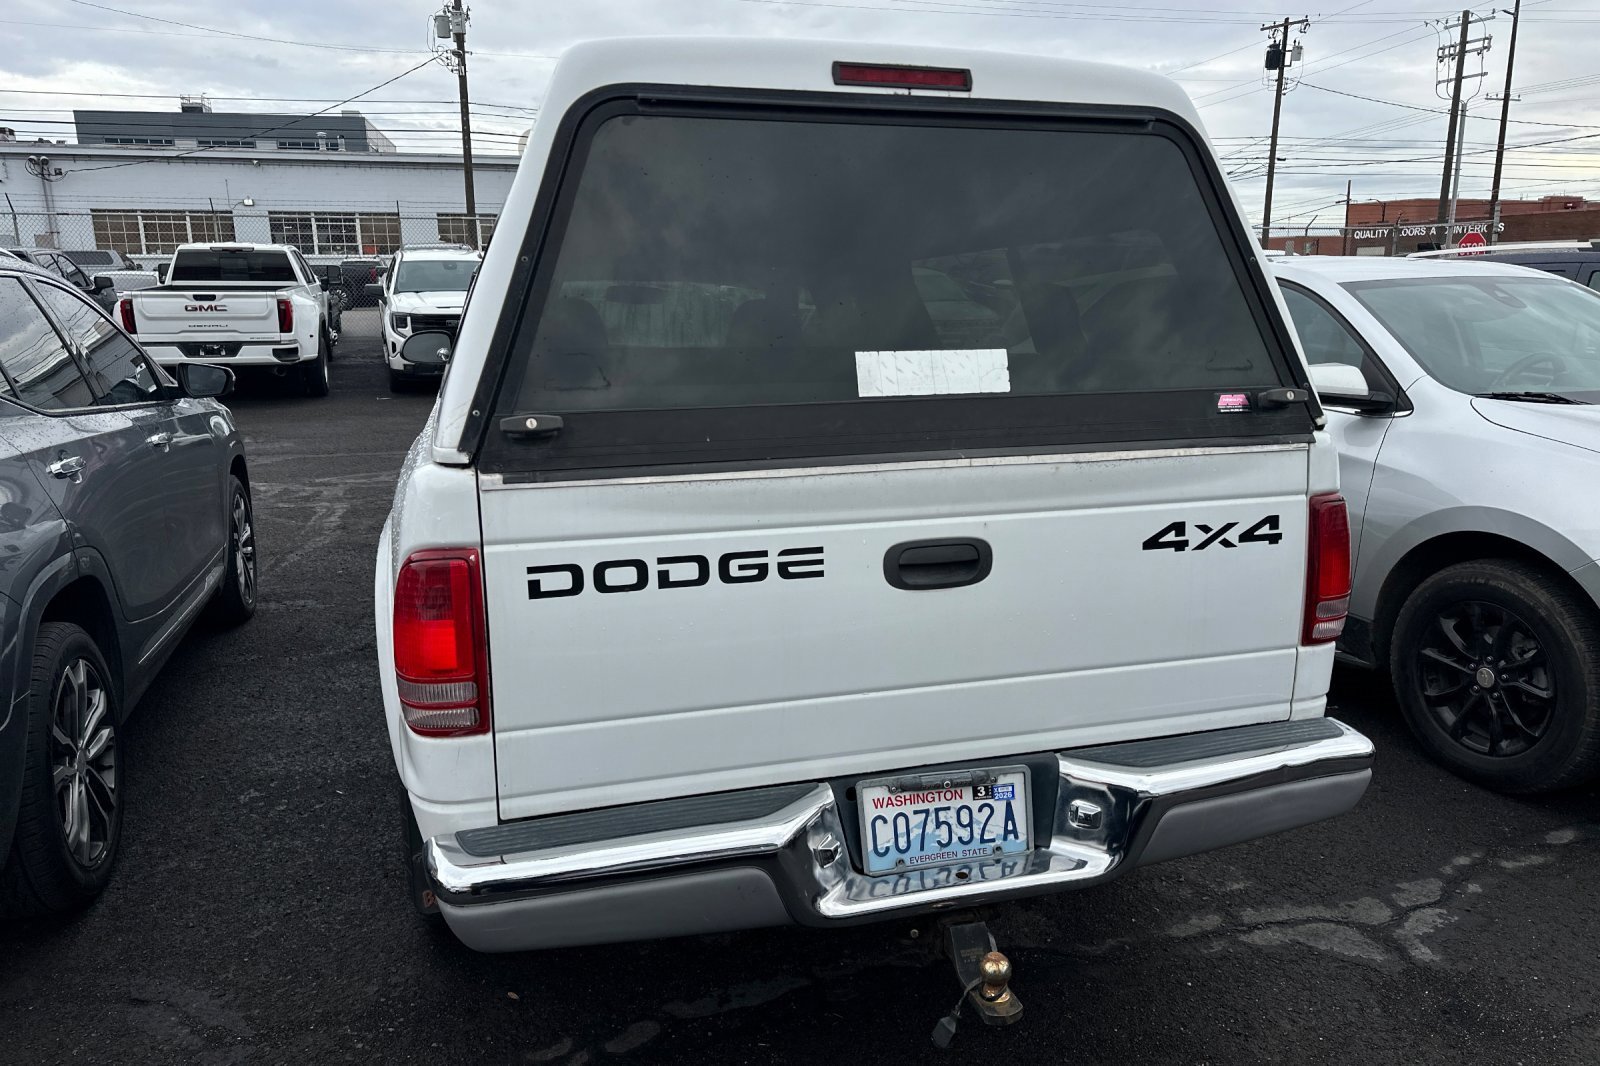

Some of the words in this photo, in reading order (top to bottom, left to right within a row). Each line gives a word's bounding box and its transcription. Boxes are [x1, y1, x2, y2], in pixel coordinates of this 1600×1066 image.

[1354, 229, 1389, 239] QUALITY
[1393, 226, 1426, 238] OORS
[1453, 222, 1505, 234] INTERIS
[184, 304, 228, 312] GMC
[526, 546, 825, 600] DODGE
[872, 788, 964, 810] WASHINGTON
[977, 786, 986, 796] 3
[994, 792, 1013, 800] 2026
[870, 799, 1020, 858] C07592A
[909, 850, 958, 865] EVERGREEN
[961, 847, 988, 857] STATE
